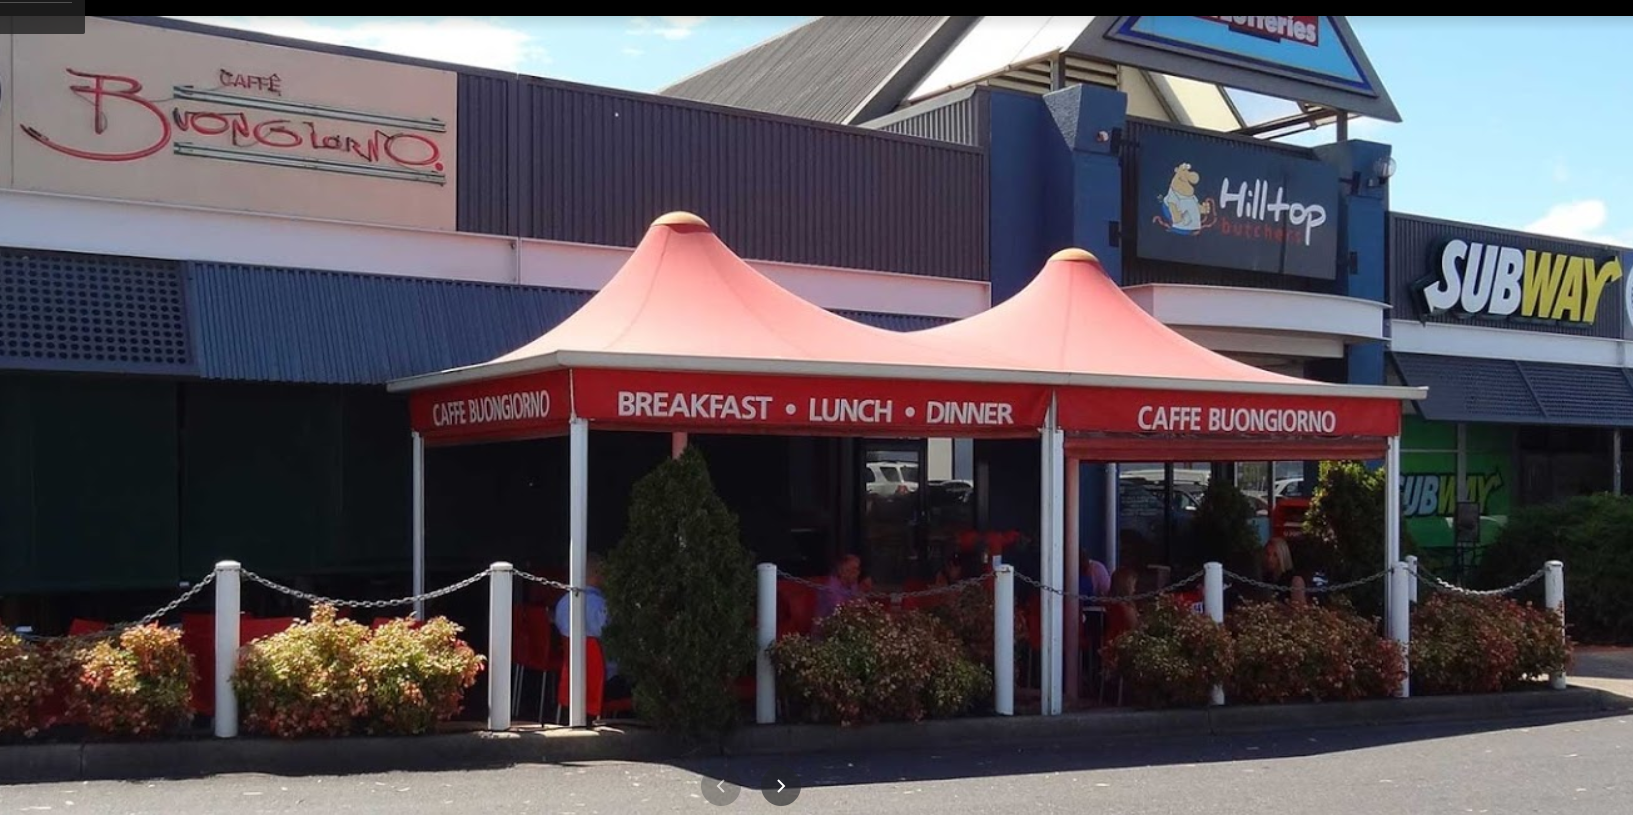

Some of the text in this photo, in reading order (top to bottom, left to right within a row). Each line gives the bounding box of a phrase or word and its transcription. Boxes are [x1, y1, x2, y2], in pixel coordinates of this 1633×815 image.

[1220, 16, 1317, 43] otteries
[1219, 177, 1327, 246] Hilltop
[1424, 239, 1623, 326] SUBWAY
[433, 390, 550, 426] CAFFE BUONGIORNO
[618, 391, 1014, 425] BREAKFAST LUNCH DINNER
[1137, 405, 1336, 433] CAFFE BUONGIORNO
